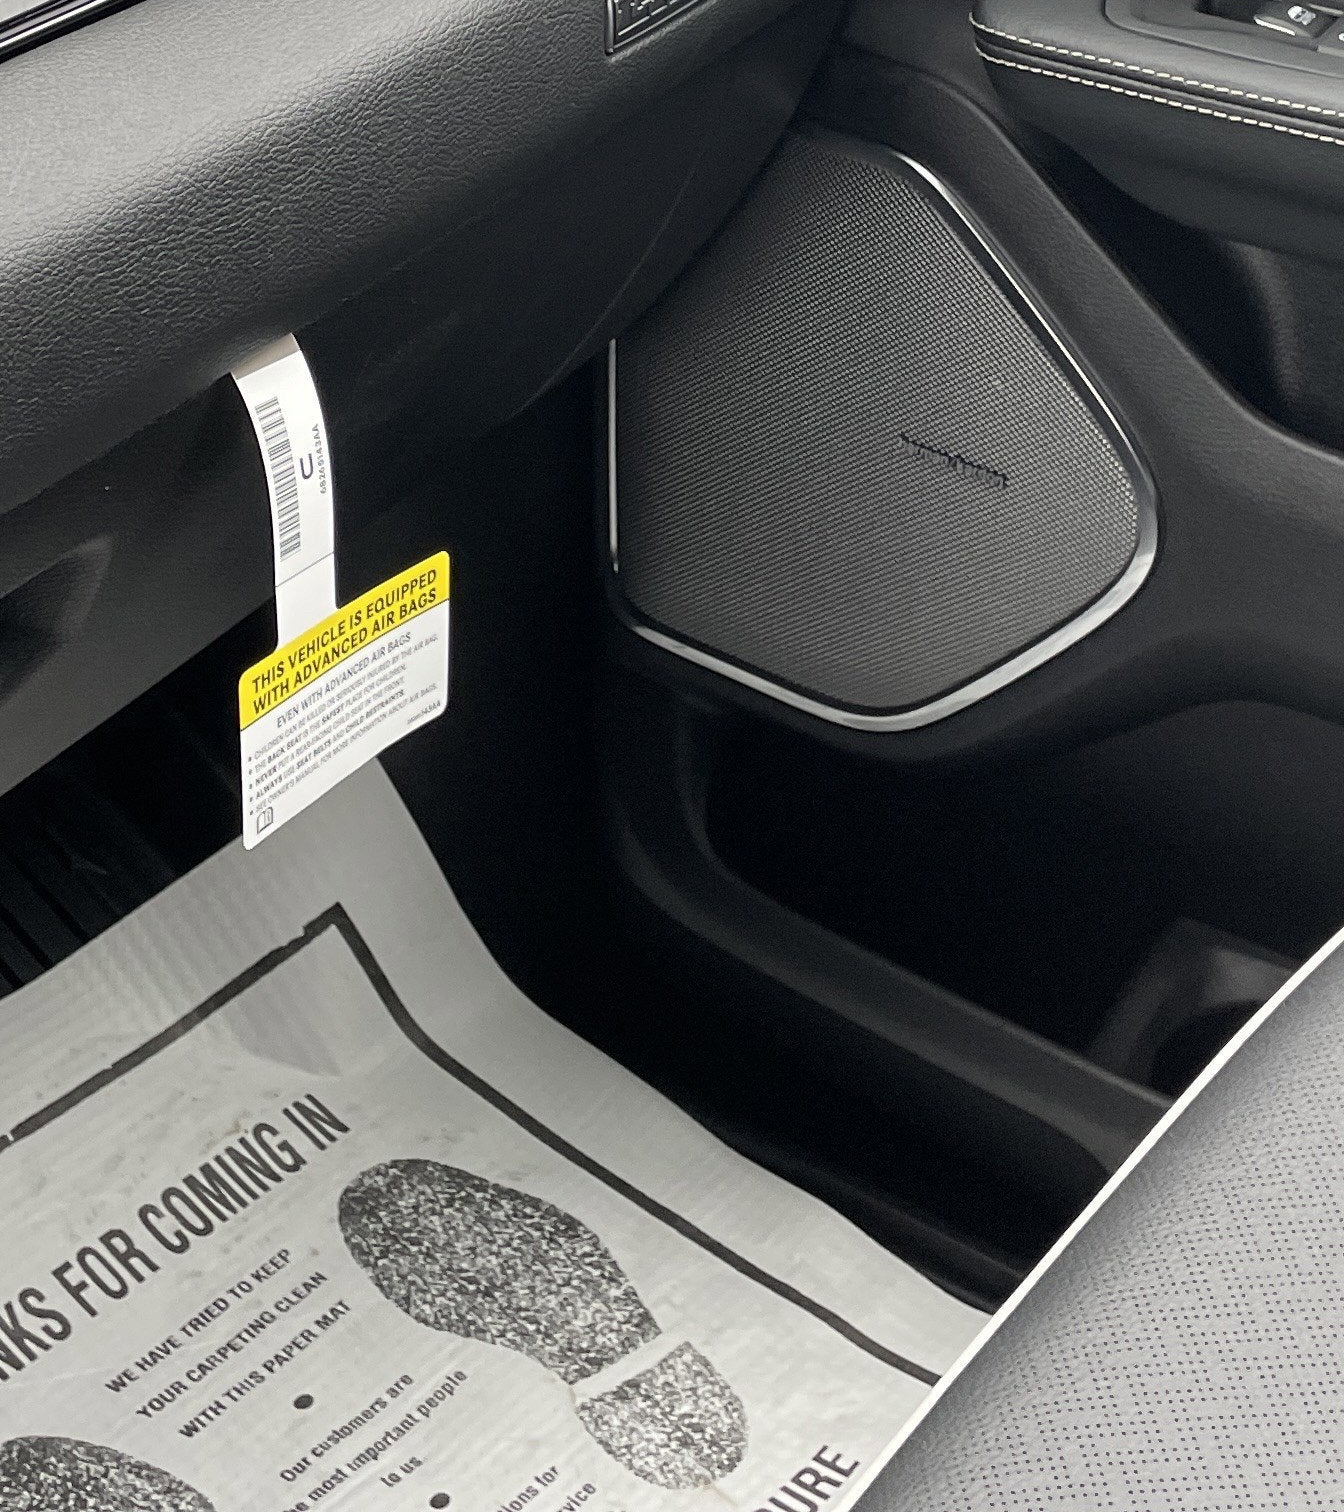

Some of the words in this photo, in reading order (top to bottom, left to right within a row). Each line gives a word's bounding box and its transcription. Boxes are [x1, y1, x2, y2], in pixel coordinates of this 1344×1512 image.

[252, 660, 284, 693] THIS
[288, 619, 346, 669] VEHICLE
[349, 611, 362, 629] IS
[366, 569, 437, 620] EQUIPPED
[253, 681, 290, 715] WITH
[293, 627, 368, 688] ADVANCED
[372, 612, 395, 637] AIR
[399, 587, 437, 620] BAGS
[277, 703, 299, 728] EVEN
[301, 687, 323, 710] WITH
[325, 656, 370, 694] ADVANCED
[371, 644, 387, 664] AIR
[387, 631, 412, 655] BAGS
[51, 1228, 161, 1317] FOR
[137, 1122, 308, 1255] COMING
[282, 1093, 351, 1151] IN
[105, 1368, 140, 1393] WE
[135, 1335, 183, 1372] HAVE
[179, 1296, 231, 1338] TRIED
[226, 1280, 254, 1300] TO
[250, 1248, 291, 1283] KEEP
[136, 1380, 190, 1419] YOUR
[185, 1310, 278, 1383] CARPETING
[274, 1271, 329, 1314] CLEAN
[178, 1400, 228, 1439] WITH
[222, 1370, 266, 1403] THIS
[262, 1328, 318, 1374] PAPER
[313, 1299, 352, 1331] MAT
[279, 1456, 312, 1482] Our
[310, 1397, 388, 1458] customers
[386, 1374, 415, 1399] are
[308, 1467, 350, 1502] most
[346, 1413, 421, 1472] important
[416, 1370, 468, 1419] people
[380, 1471, 403, 1487] to
[534, 1465, 560, 1487] for
[753, 1445, 861, 1512] URE
